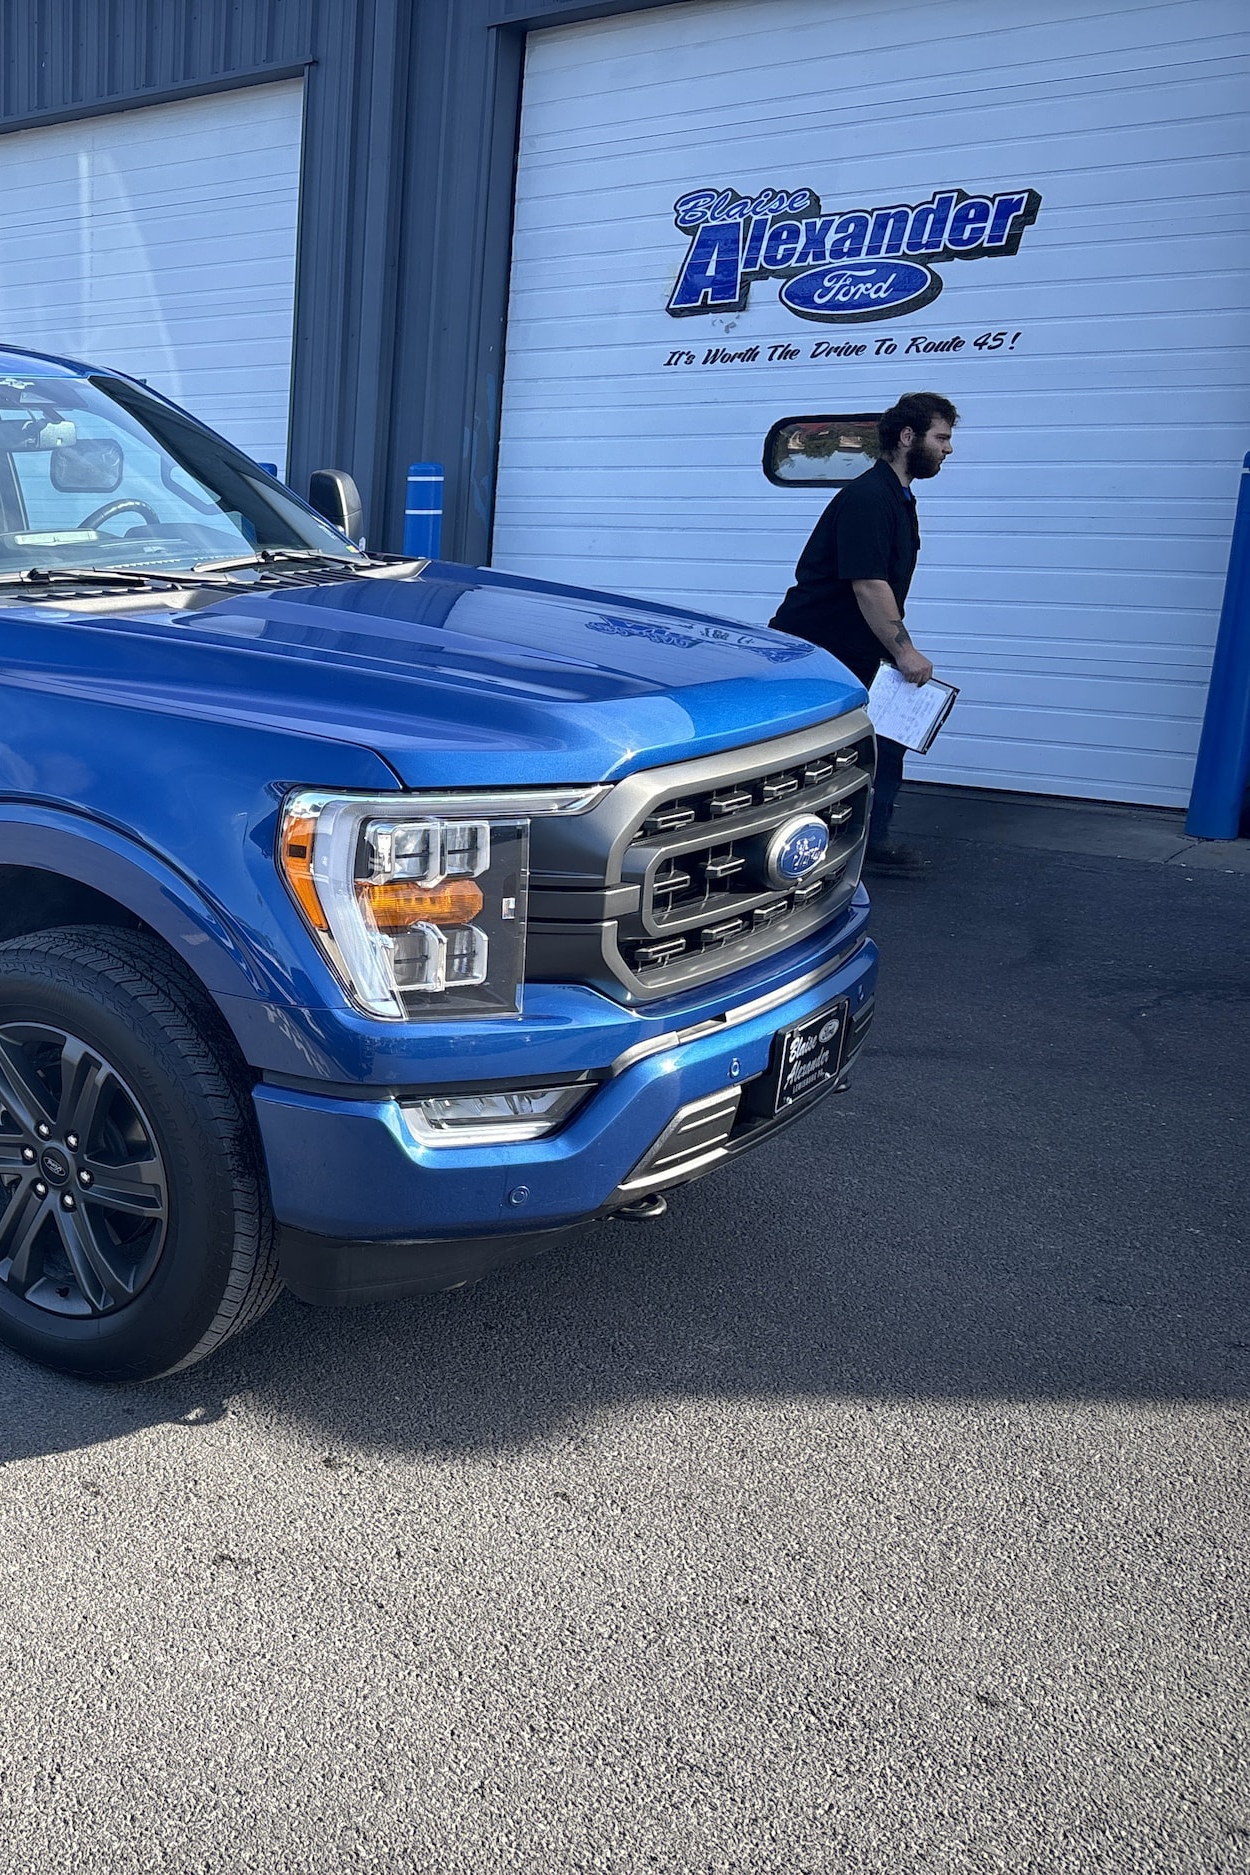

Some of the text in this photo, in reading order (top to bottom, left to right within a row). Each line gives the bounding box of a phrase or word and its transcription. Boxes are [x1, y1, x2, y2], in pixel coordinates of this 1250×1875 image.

[676, 187, 812, 228] Blaise
[667, 189, 1031, 310] Alexander
[812, 267, 897, 305] Ford
[663, 350, 696, 367] It's
[701, 345, 760, 366] Worth
[767, 343, 801, 362] The
[810, 341, 867, 360] Drive
[874, 338, 898, 356] To
[904, 335, 966, 355] Route
[792, 835, 823, 871] Ford
